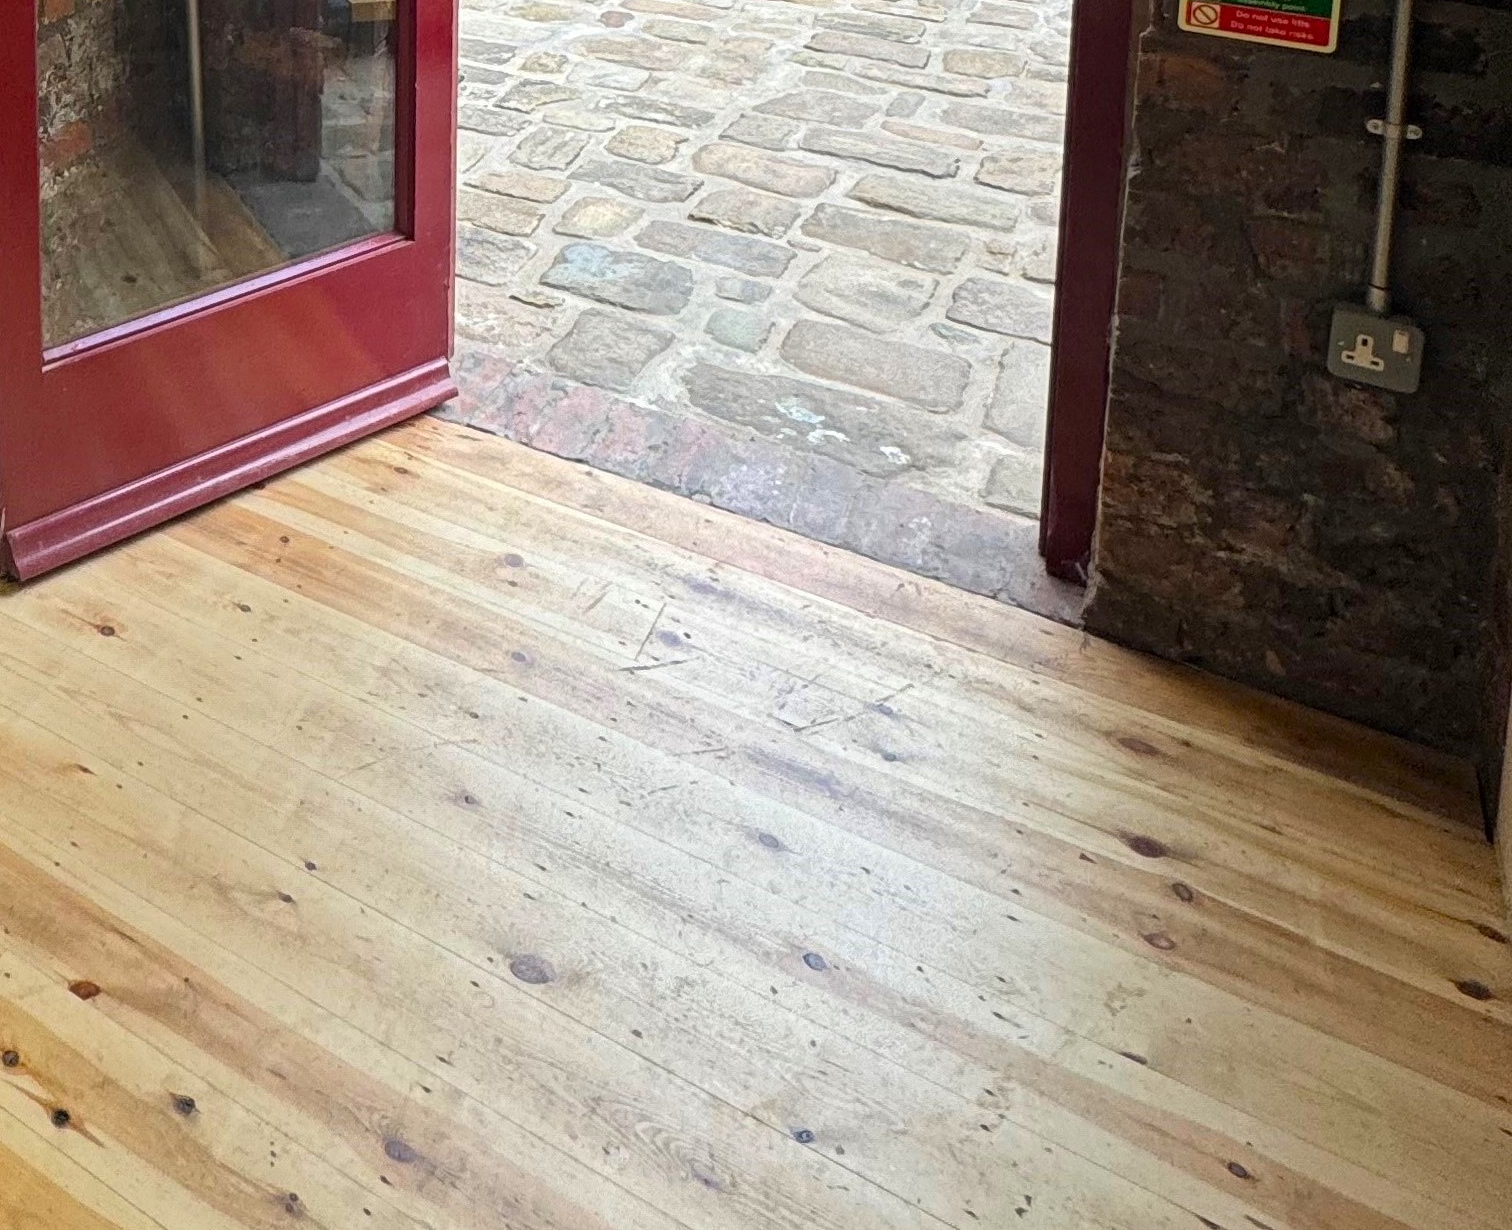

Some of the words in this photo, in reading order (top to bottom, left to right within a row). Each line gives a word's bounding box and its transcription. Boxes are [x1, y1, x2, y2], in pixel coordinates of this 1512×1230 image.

[1236, 9, 1250, 19] Do
[1252, 12, 1269, 22] not
[1230, 20, 1245, 30] Do
[1246, 23, 1264, 33] not
